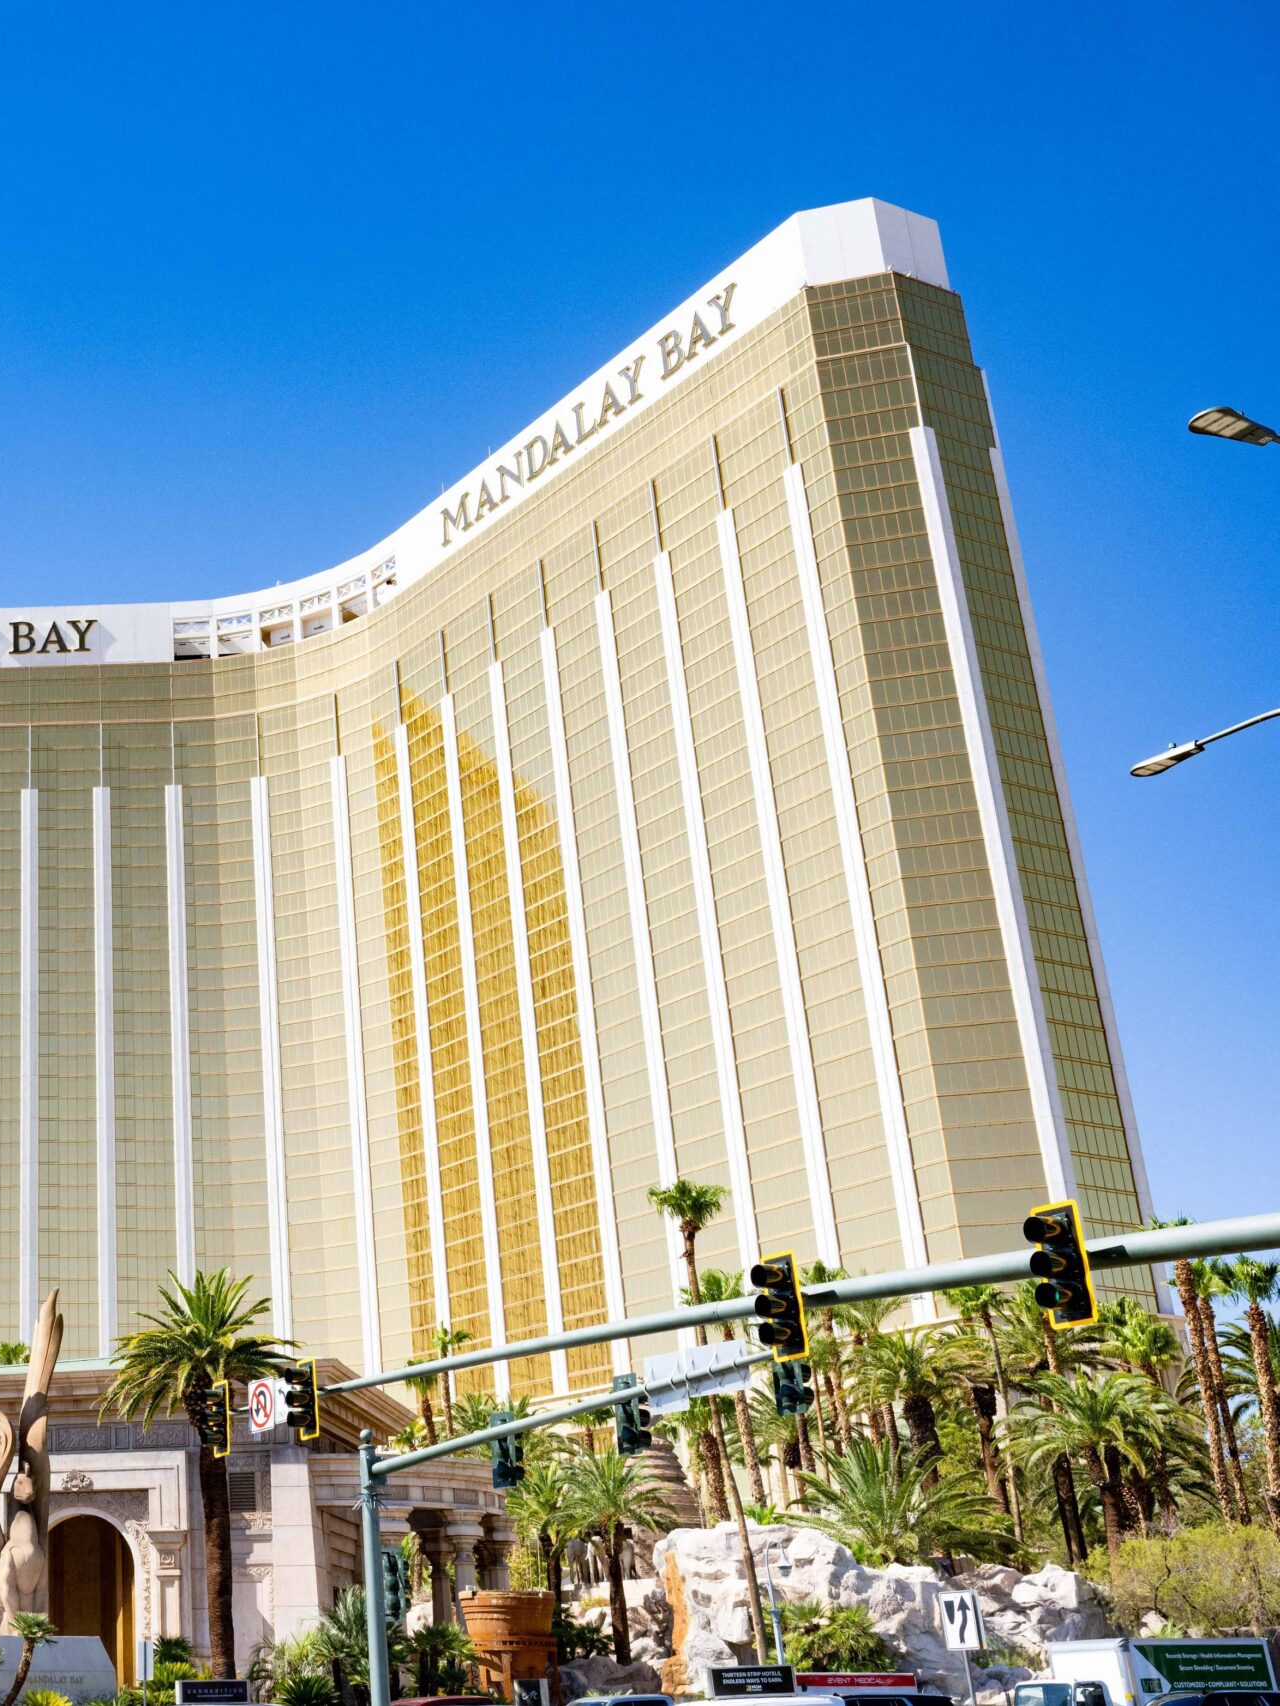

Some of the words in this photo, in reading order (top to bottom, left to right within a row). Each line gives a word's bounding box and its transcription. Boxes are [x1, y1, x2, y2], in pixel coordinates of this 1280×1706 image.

[440, 354, 646, 548] MANDALAY
[657, 282, 738, 381] BAY
[9, 619, 98, 655] BAY
[69, 1675, 84, 1684] BAY
[1239, 1680, 1268, 1688] SOLUTIONS
